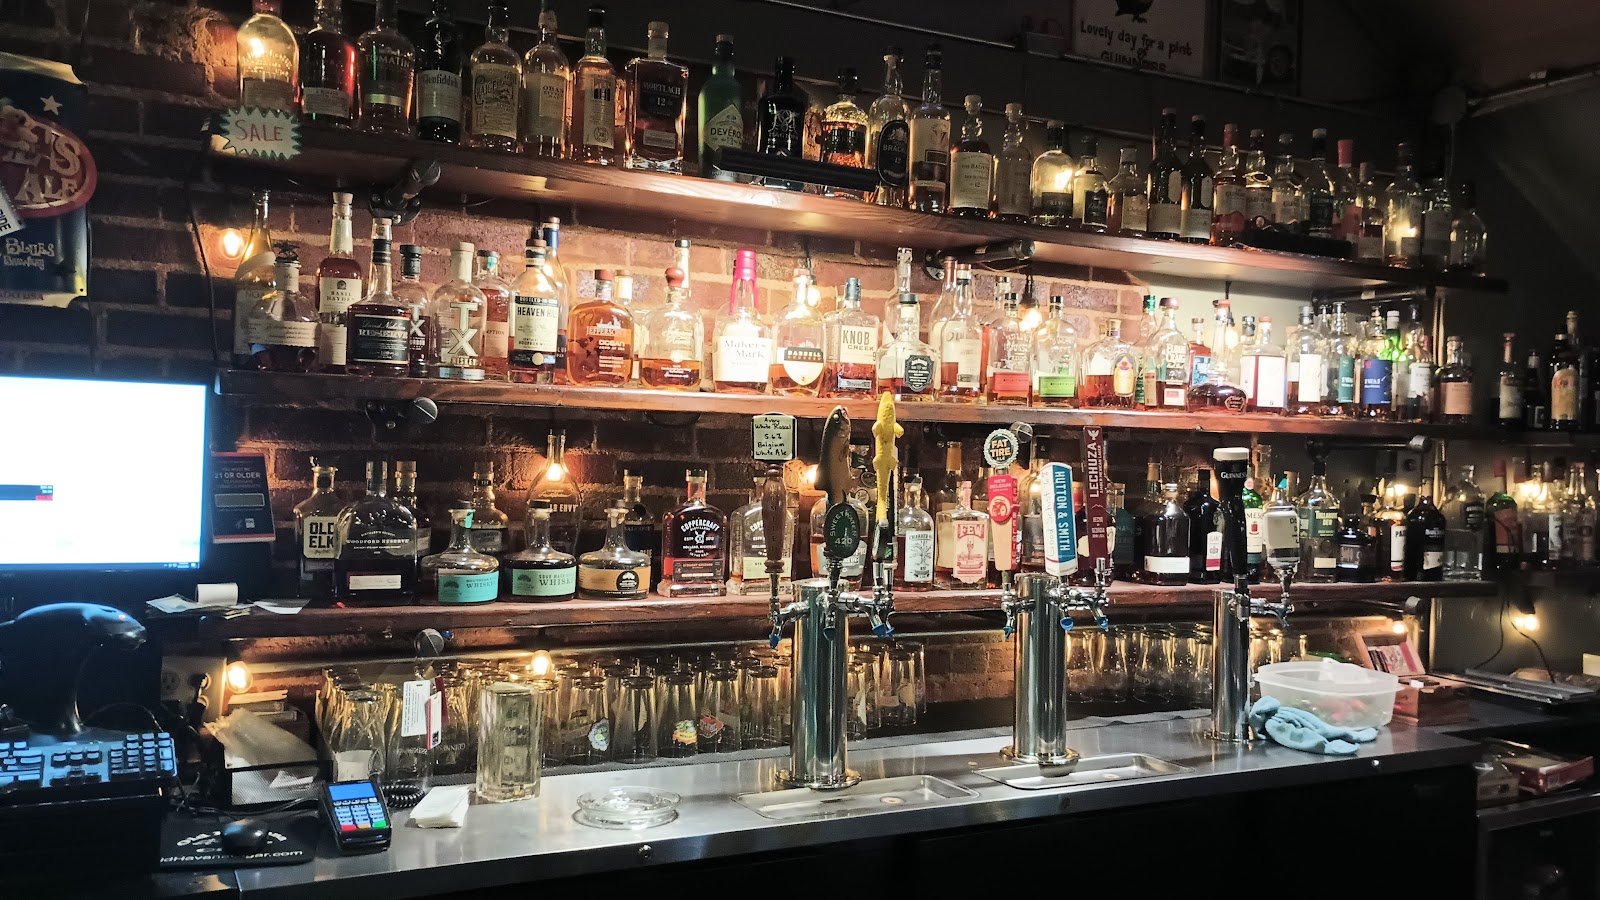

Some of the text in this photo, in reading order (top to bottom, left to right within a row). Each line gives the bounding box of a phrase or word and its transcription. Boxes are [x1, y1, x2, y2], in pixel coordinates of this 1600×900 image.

[1080, 20, 1114, 46] Lovely
[1118, 29, 1137, 51] day
[1157, 39, 1164, 51] a
[1168, 40, 1192, 59] pint
[642, 81, 681, 96] MORTLACH
[657, 97, 666, 107] 12
[234, 119, 285, 142] SALE
[710, 127, 741, 139] DEVERO
[14, 167, 79, 205] ALE
[517, 306, 545, 317] HEAVEN
[842, 329, 870, 346] KNOB
[736, 349, 765, 359] Mark
[847, 344, 875, 352] CREEK
[763, 417, 780, 425] Avery
[991, 439, 1009, 449] FAT
[775, 448, 787, 457] Ale
[990, 447, 1011, 457] TIRE
[1087, 442, 1100, 498] LECHUZA
[1054, 471, 1068, 509] HUTTON
[559, 504, 578, 513] ENVY
[309, 522, 335, 535] OLD
[681, 519, 720, 533] COPPERCRAFT
[959, 523, 985, 536] FEW
[309, 535, 334, 549] ELK
[834, 537, 853, 545] 420
[1058, 522, 1071, 551] SMITH
